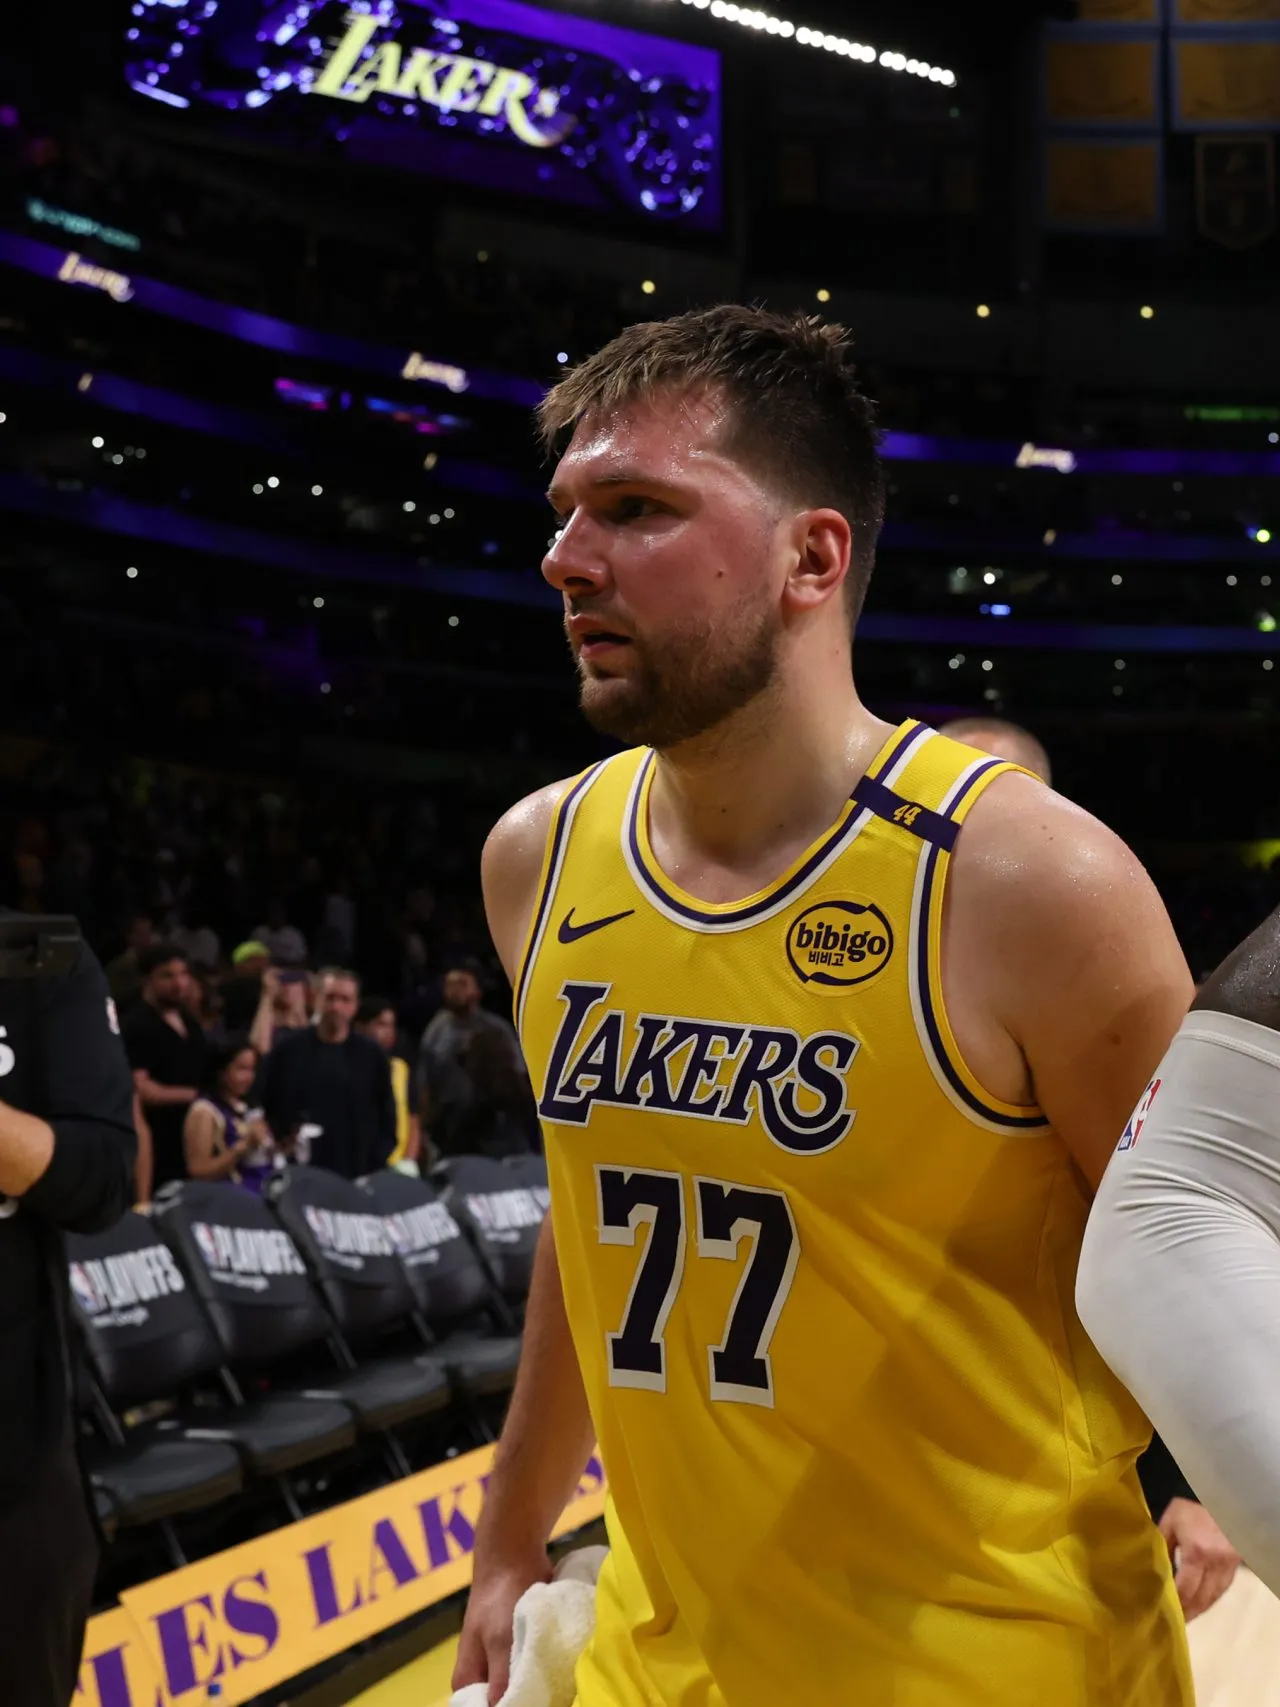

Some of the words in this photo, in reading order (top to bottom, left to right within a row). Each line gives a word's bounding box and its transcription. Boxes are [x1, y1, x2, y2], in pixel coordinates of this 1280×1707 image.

[893, 804, 922, 826] 44
[796, 922, 886, 963] bibigo
[808, 951, 845, 967] 비비고
[538, 980, 860, 1155] LAKERS
[593, 1163, 800, 1408] 77
